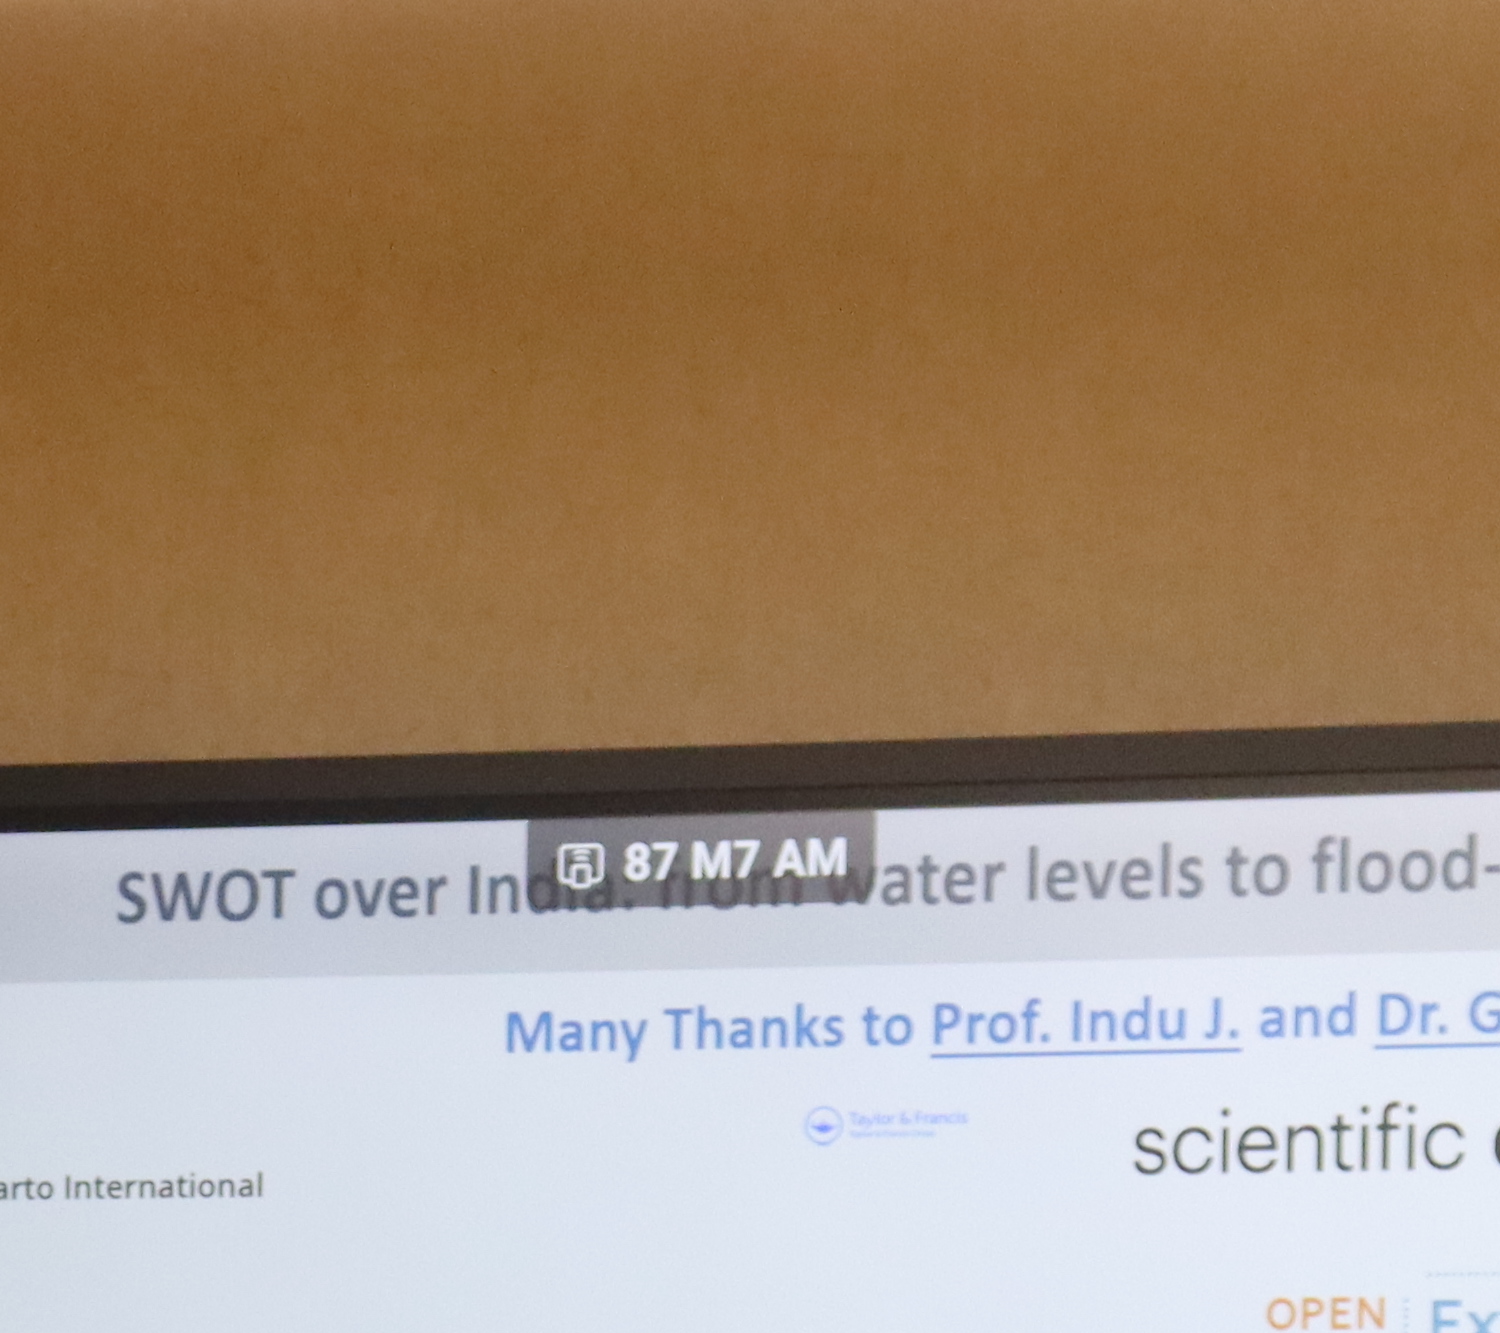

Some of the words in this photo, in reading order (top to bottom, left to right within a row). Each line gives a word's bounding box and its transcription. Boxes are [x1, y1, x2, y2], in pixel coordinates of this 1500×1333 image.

[116, 867, 296, 926] SWOT
[313, 874, 447, 921] over
[824, 853, 1007, 907] water
[1026, 840, 1205, 904] levels
[1224, 844, 1292, 898] to
[624, 840, 676, 884] 87
[691, 837, 757, 881] M7
[773, 834, 848, 879] AM
[505, 1011, 648, 1058] Many
[663, 1002, 845, 1052] Thanks
[861, 1006, 915, 1048] to
[932, 997, 1051, 1047] Prof.
[1071, 995, 1187, 1044] Indu
[1203, 996, 1240, 1041] J.
[1259, 990, 1357, 1040] and
[1378, 992, 1448, 1037] Dr.
[1133, 1100, 1465, 1176] scientific
[64, 1171, 264, 1201] International
[1265, 1295, 1387, 1332] OPEN
